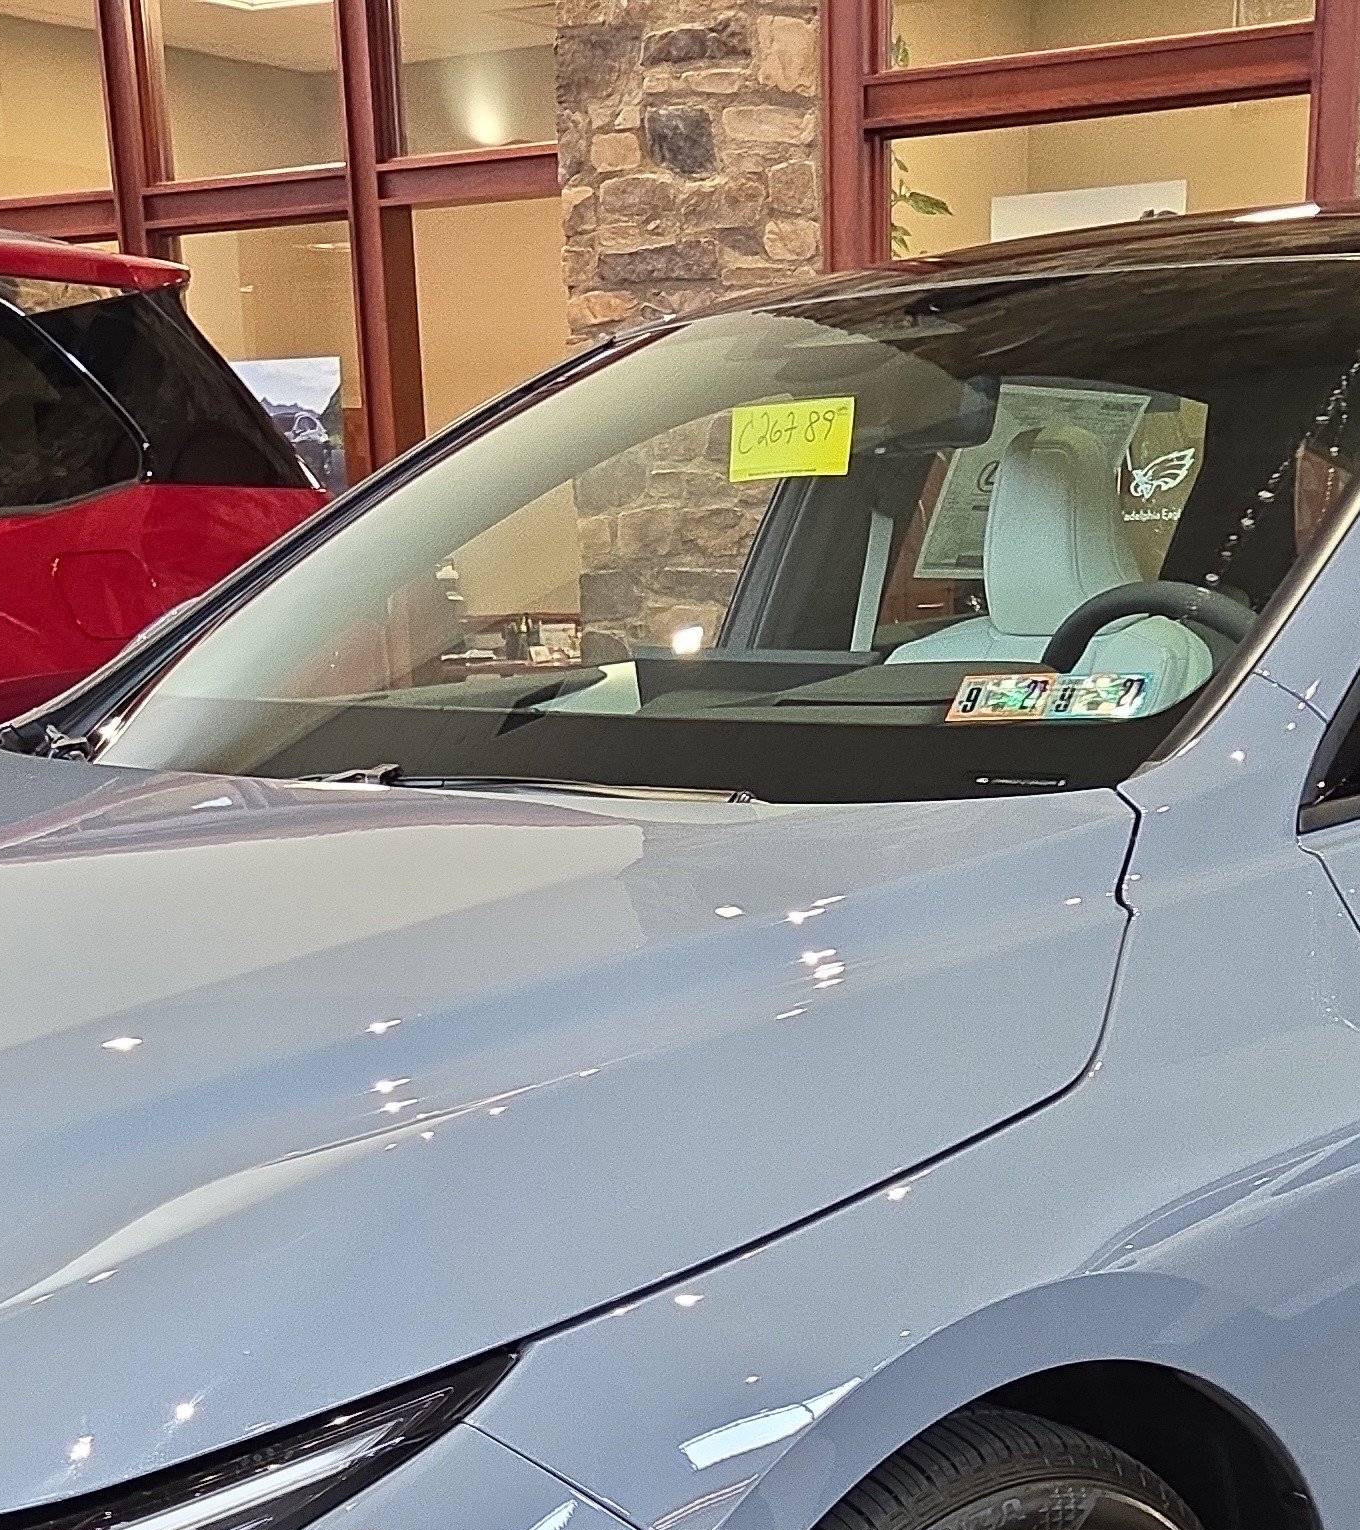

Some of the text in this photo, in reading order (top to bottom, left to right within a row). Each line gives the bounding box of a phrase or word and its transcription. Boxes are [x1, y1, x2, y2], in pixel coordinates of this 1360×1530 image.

[961, 679, 1050, 714] 9 27
[1054, 678, 1145, 713] 9 27
